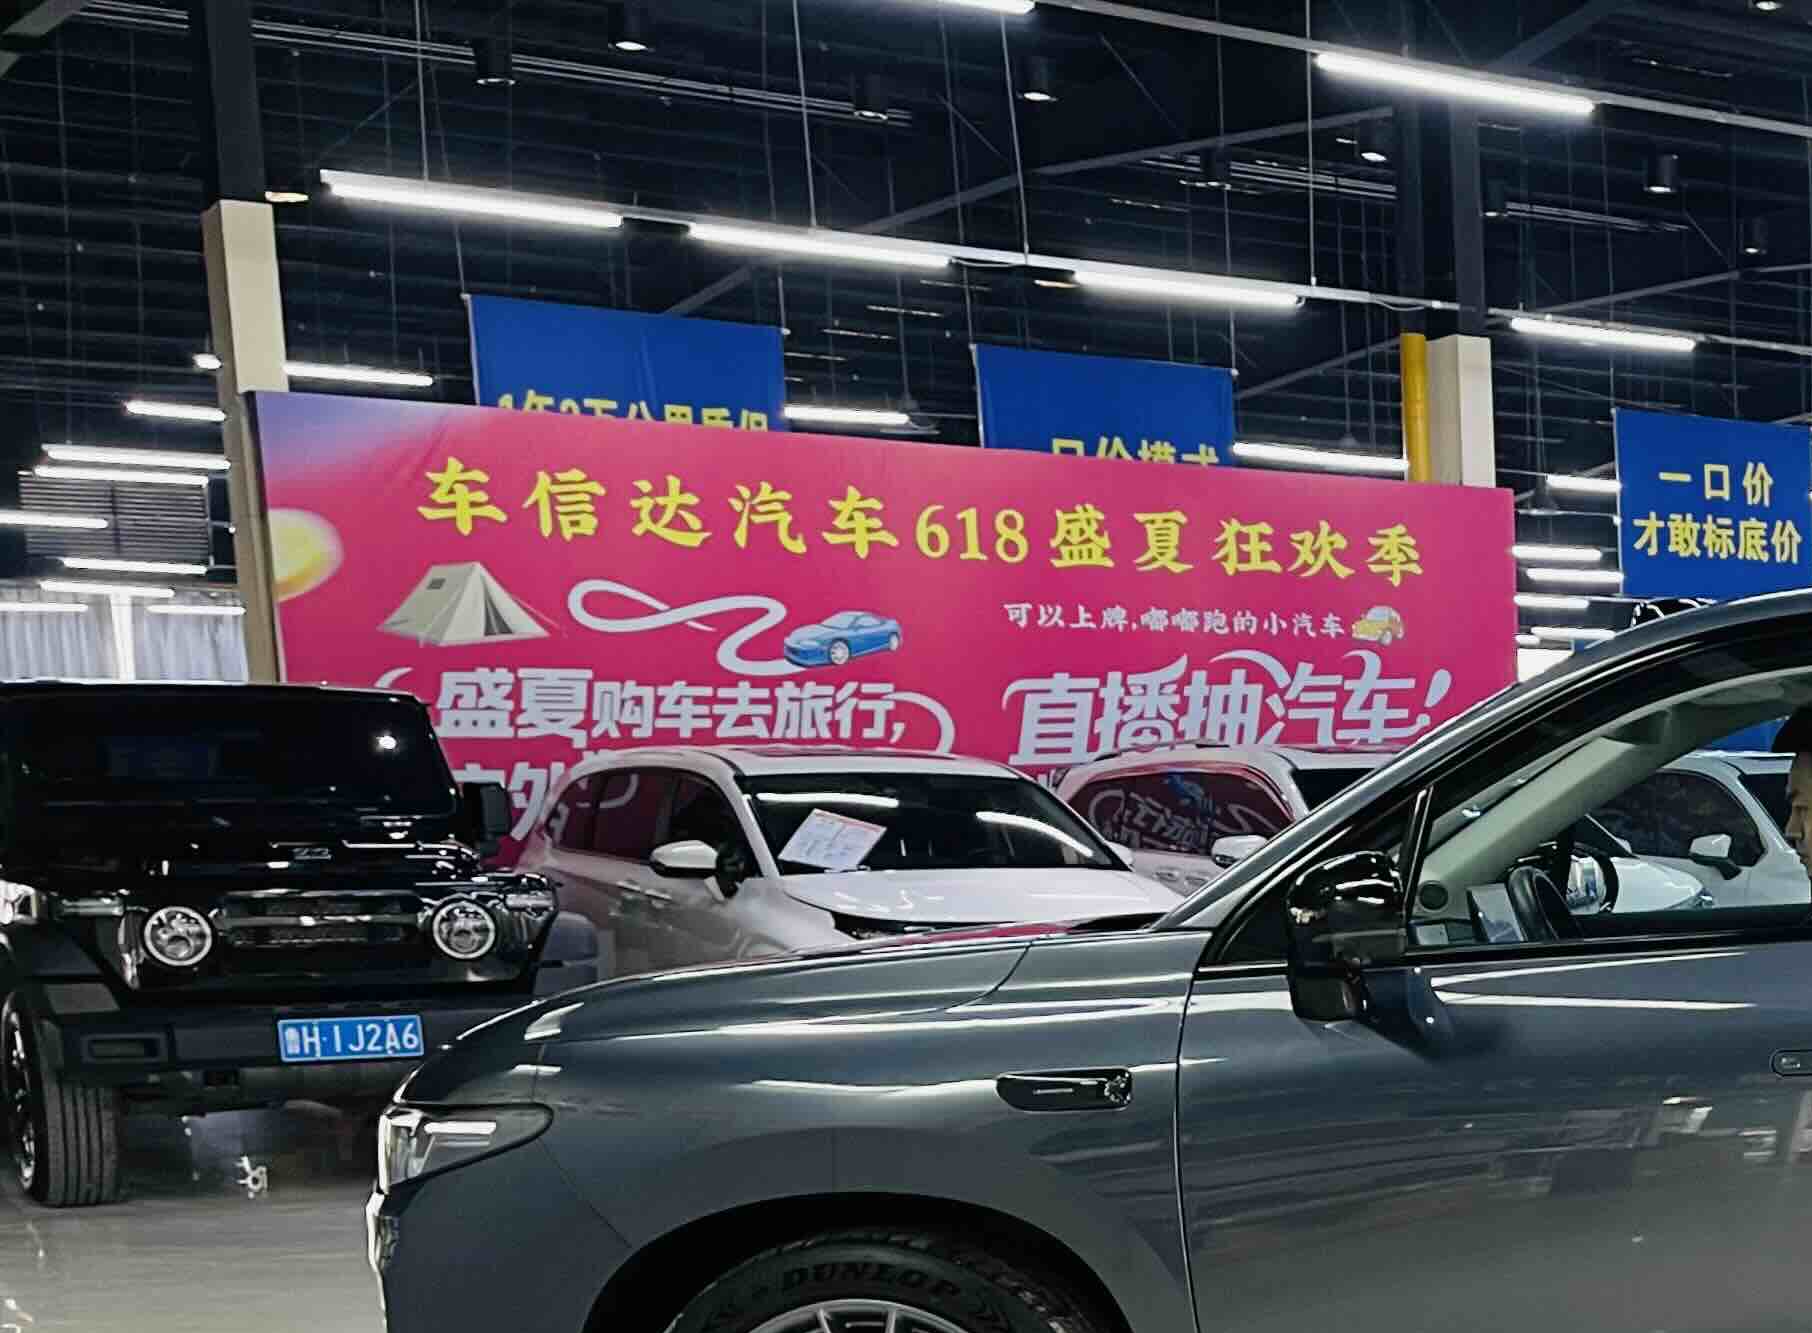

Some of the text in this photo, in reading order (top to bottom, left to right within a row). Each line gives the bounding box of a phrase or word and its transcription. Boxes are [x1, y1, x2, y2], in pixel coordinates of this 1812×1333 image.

[417, 457, 1423, 587] 车信达汽车618盛夏狂欢季
[1658, 461, 1774, 508] 一口价
[1632, 511, 1803, 564] 才敢标底价
[1003, 649, 1452, 767] 直播抽汽车!
